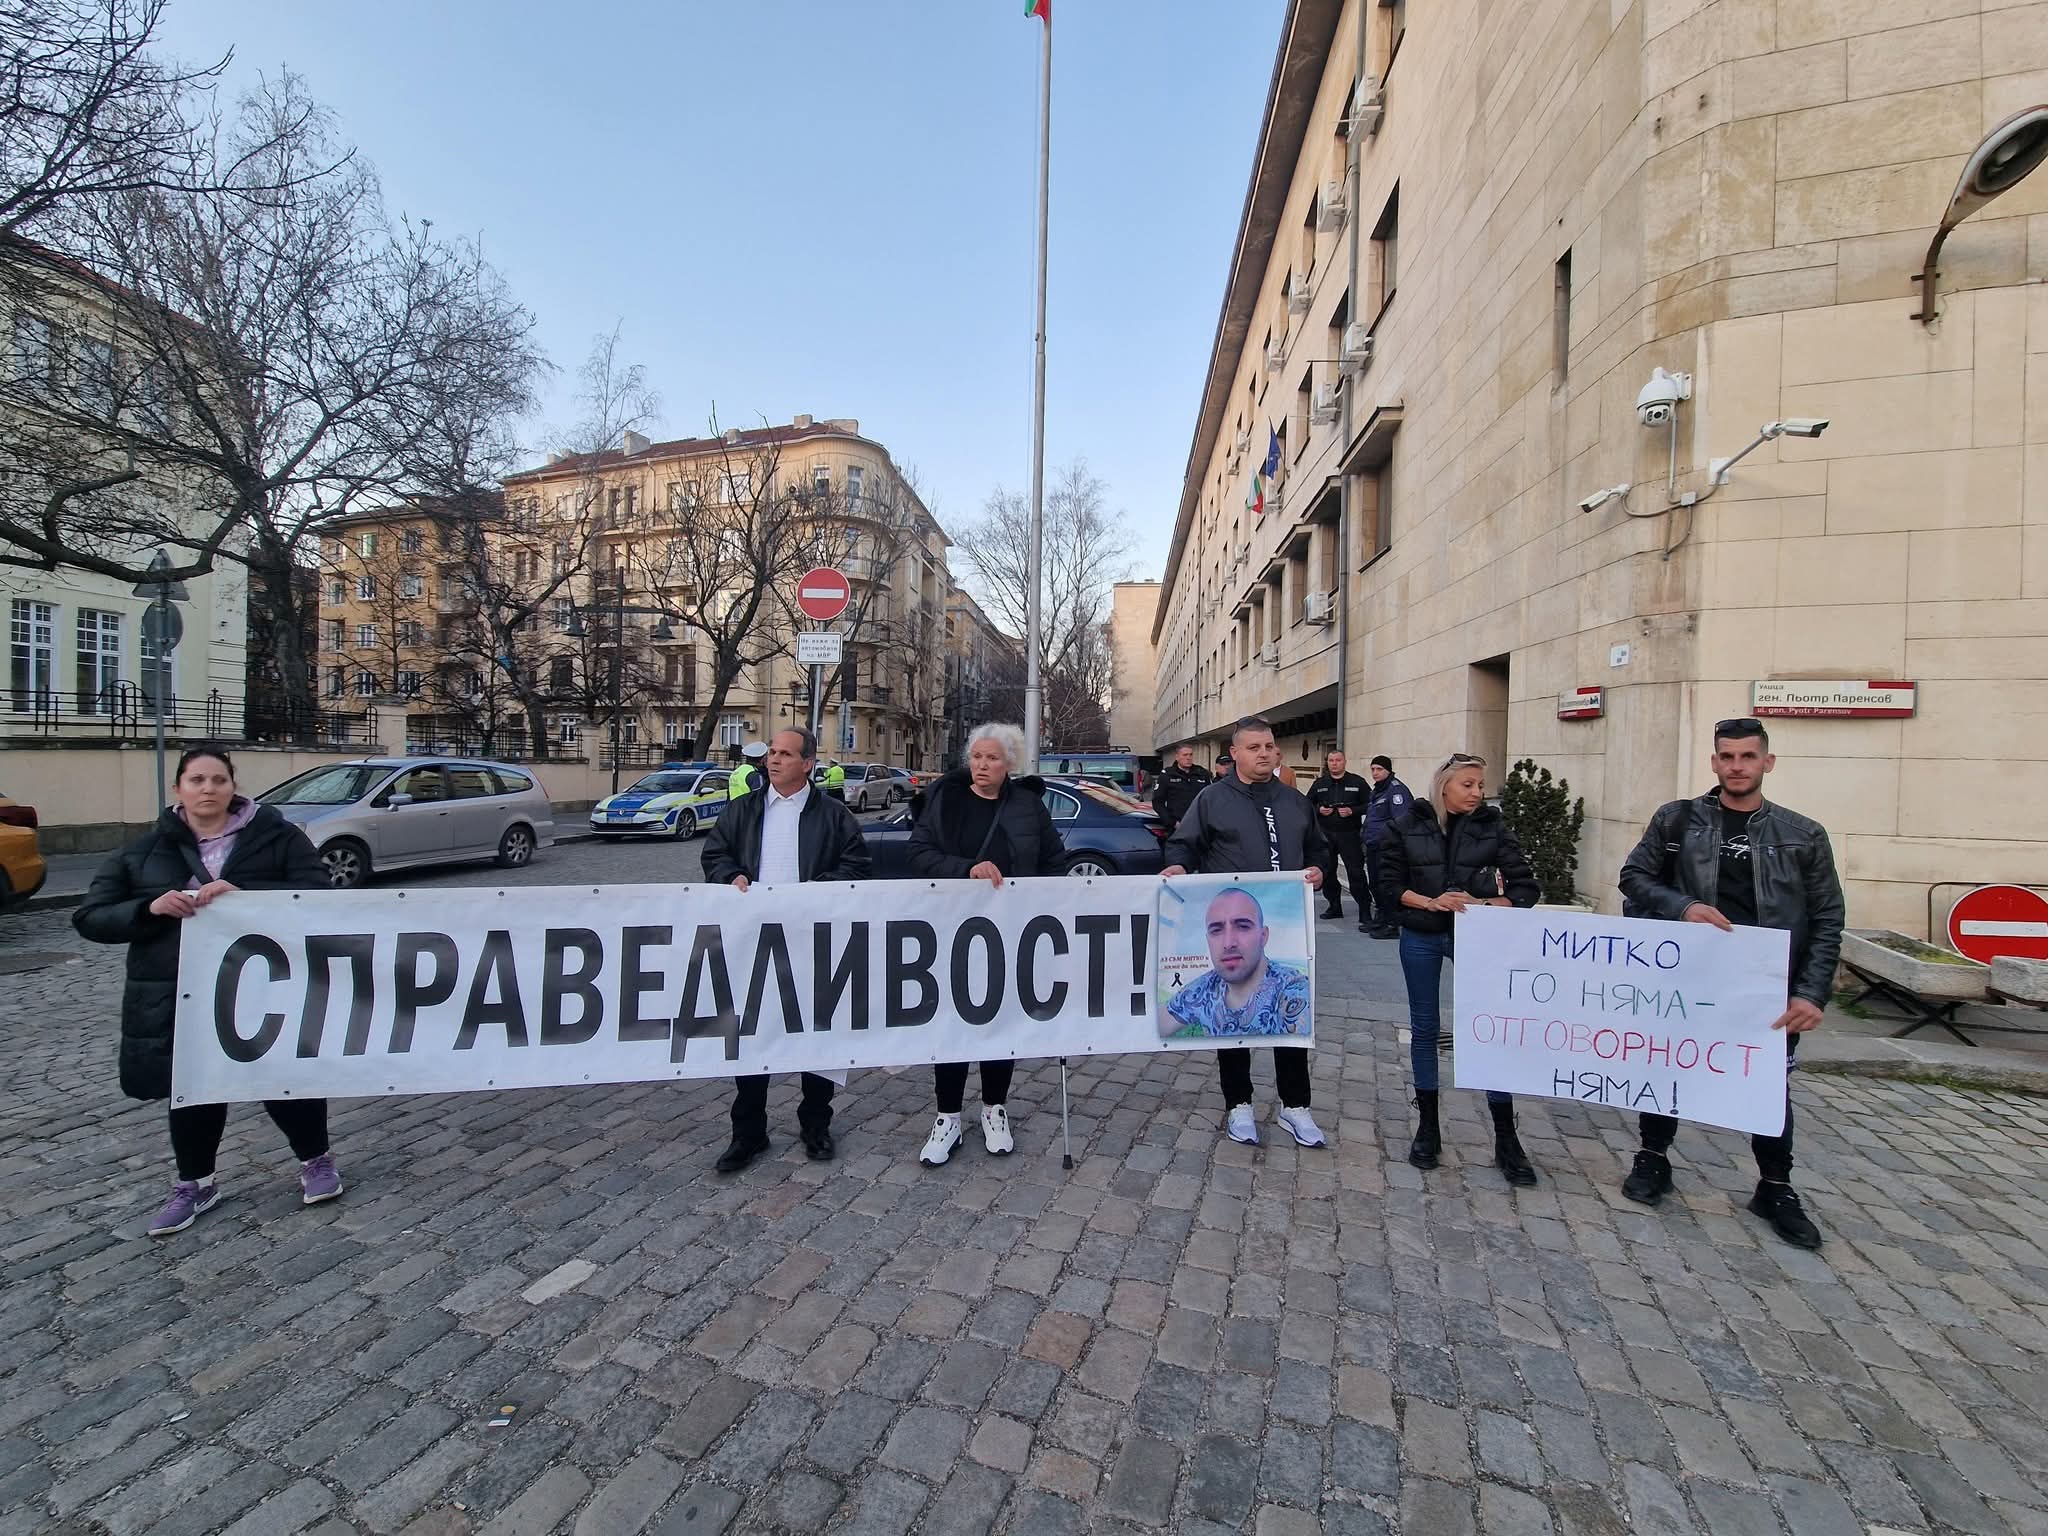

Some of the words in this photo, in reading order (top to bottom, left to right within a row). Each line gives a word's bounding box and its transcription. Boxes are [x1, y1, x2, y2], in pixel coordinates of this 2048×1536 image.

[1758, 694, 1782, 702] ген.
[1786, 693, 1829, 704] Пьотр
[1833, 694, 1892, 705] Паренсов
[1768, 708, 1786, 716] gen.
[1263, 807, 1278, 843] NIKE
[1543, 928, 1681, 970] МИТКО
[213, 913, 1150, 1063] СПРАВЕДЛИВОСТ!
[1508, 969, 1557, 1004] ГО
[1472, 1013, 1763, 1079] ОТГОВОРНОСТ
[1553, 1067, 1680, 1116] НЯМА!
